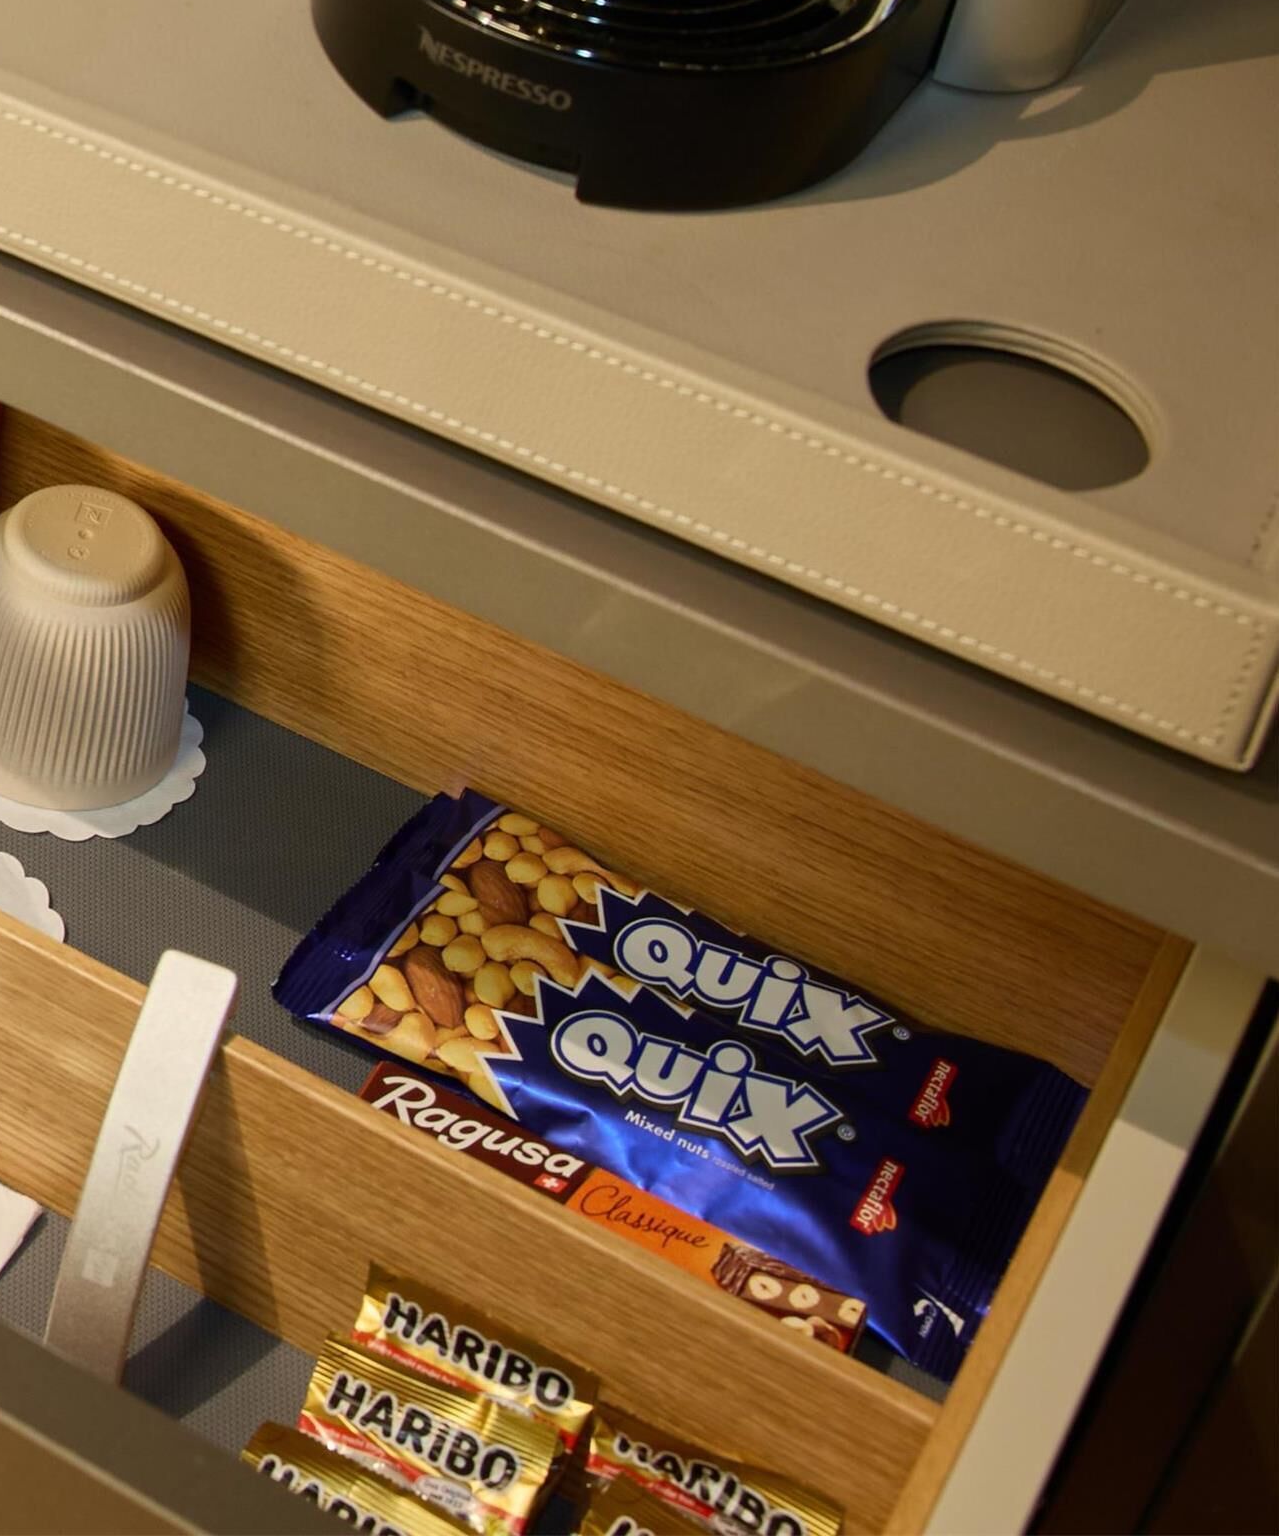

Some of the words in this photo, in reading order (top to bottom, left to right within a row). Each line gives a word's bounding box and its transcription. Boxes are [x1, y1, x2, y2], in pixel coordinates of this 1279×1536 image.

[418, 26, 572, 112] NESPRESSO
[624, 1108, 676, 1142] Mixed
[678, 1136, 710, 1160] nuts
[914, 1060, 952, 1122] nectaflor
[372, 1075, 586, 1179] Ragusa
[580, 1184, 710, 1249] Classique
[856, 1161, 898, 1230] nectaflor
[382, 1293, 574, 1410] HARIBO
[325, 1371, 522, 1493] HARIBO
